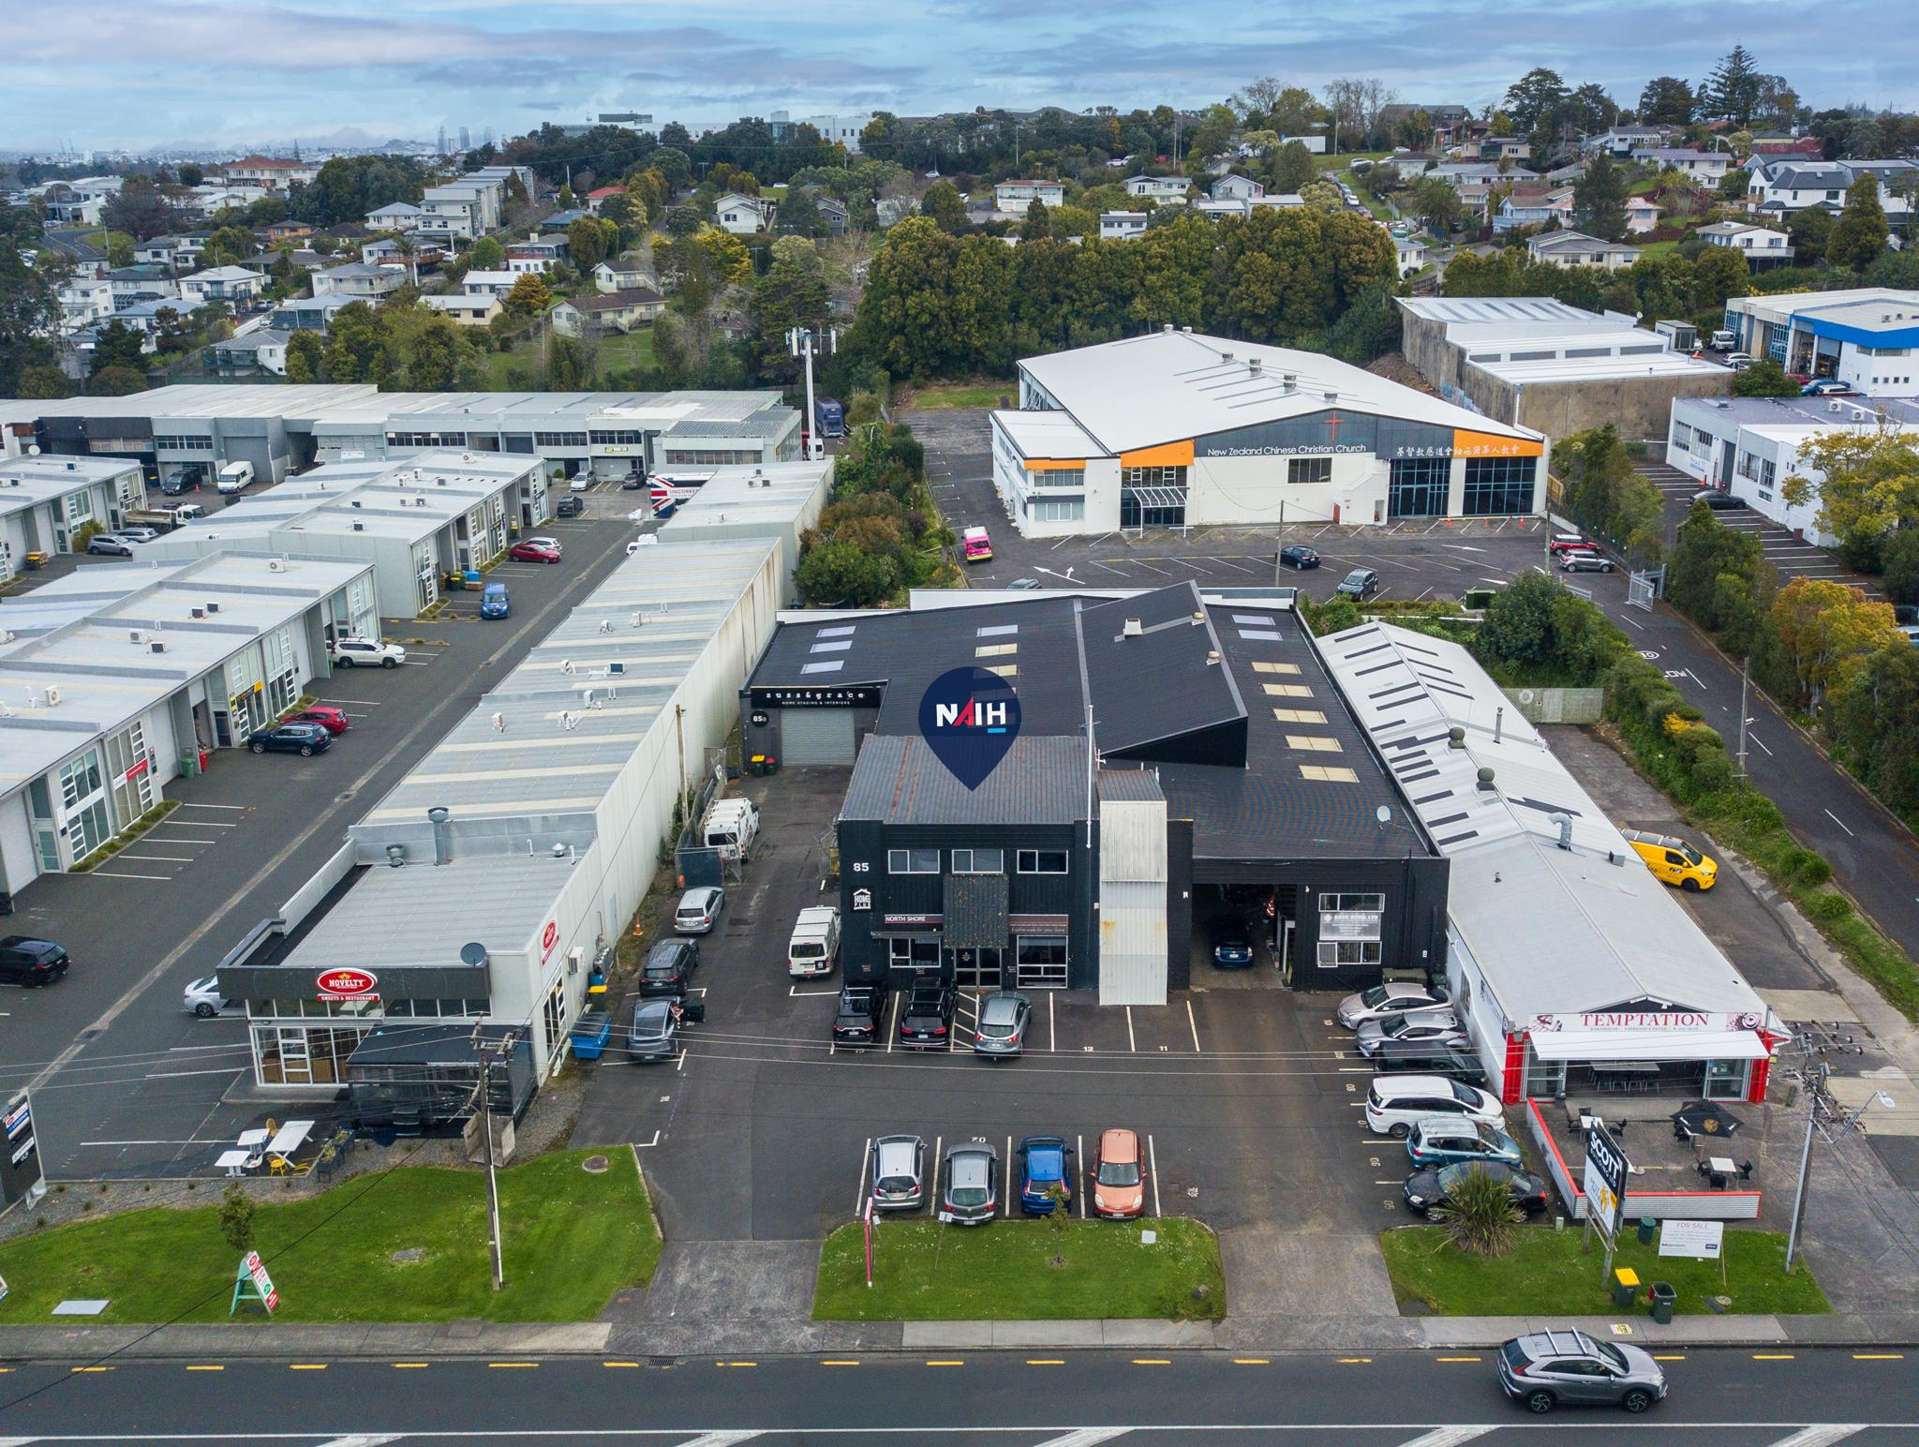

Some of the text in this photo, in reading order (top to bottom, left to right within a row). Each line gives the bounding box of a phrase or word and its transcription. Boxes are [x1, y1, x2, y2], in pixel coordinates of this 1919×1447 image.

[1207, 443, 1367, 456] New Zealand Chinese Christian Church
[853, 862, 870, 872] 85
[329, 979, 365, 987] NOVELTY
[1580, 1013, 1709, 1027] TEMPTATION
[1590, 1131, 1620, 1179] SCOTT
